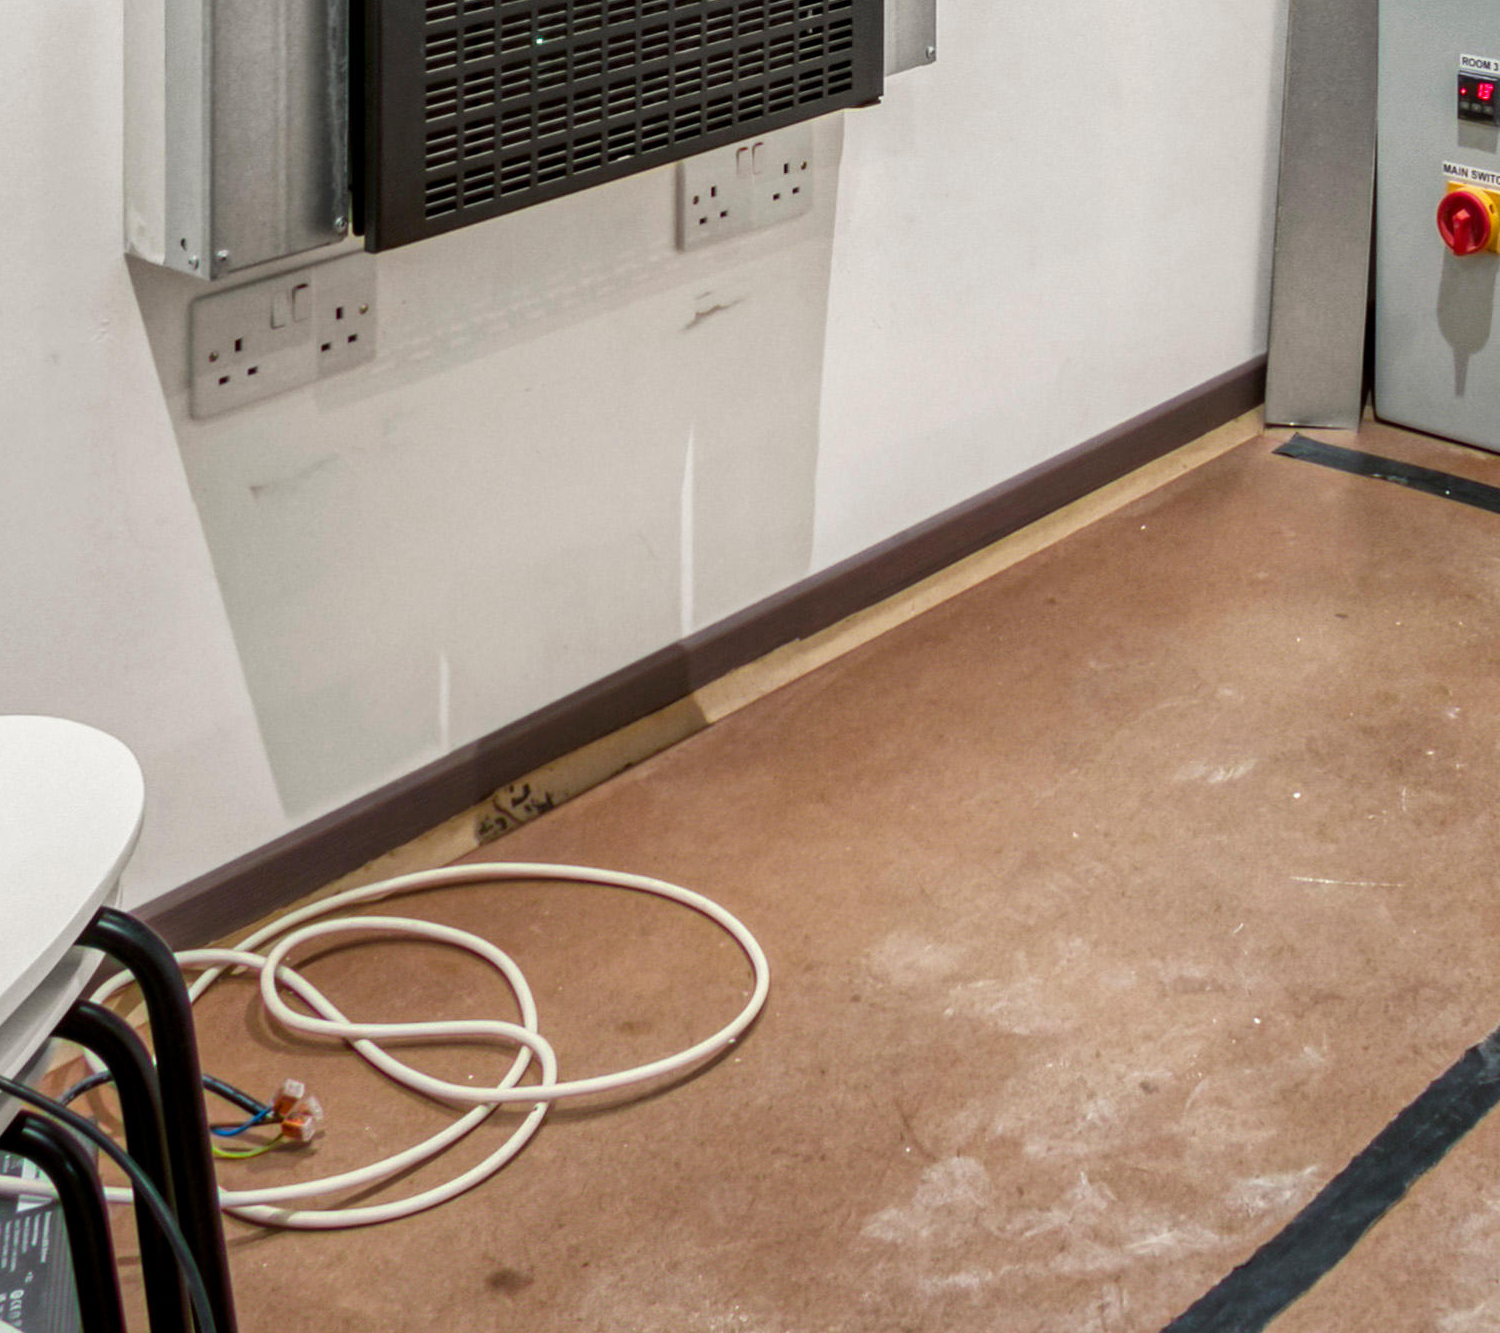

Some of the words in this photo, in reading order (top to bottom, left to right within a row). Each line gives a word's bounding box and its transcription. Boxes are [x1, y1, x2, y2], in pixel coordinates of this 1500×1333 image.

[1461, 56, 1491, 70] ROOM
[1493, 63, 1499, 72] 3
[1443, 164, 1470, 178] MAIN
